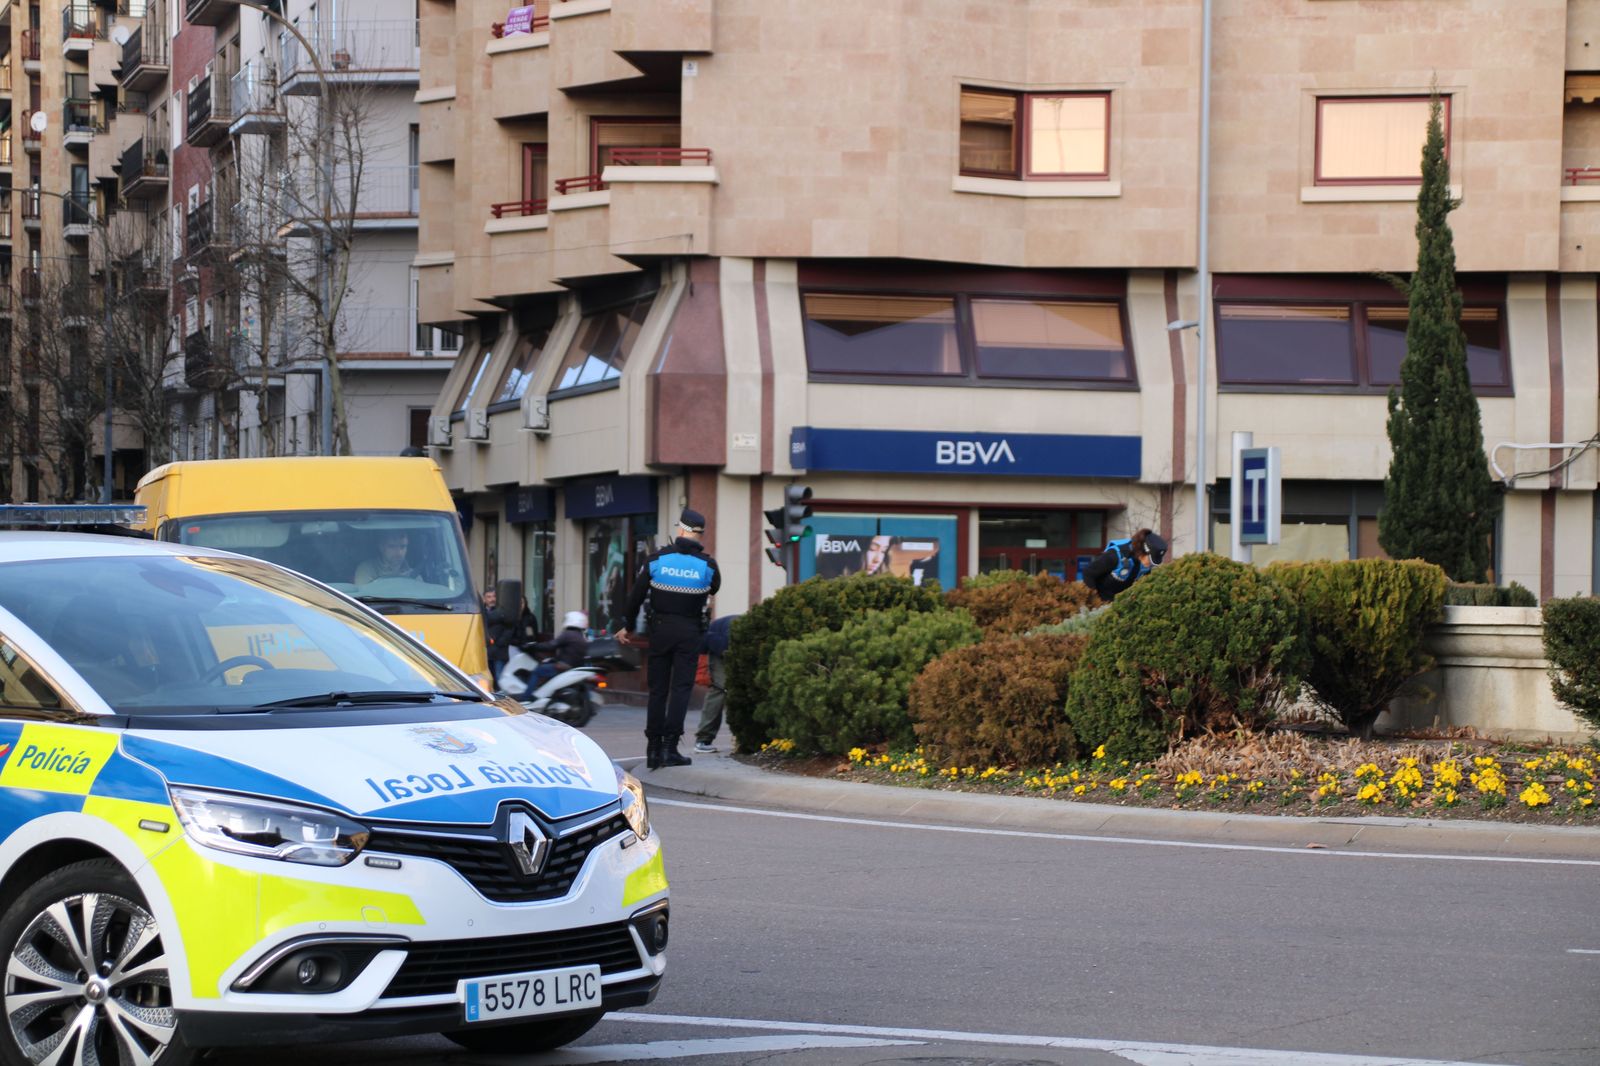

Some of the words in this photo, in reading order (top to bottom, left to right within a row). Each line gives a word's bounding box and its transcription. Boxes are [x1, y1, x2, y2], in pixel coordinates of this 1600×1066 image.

[936, 439, 1016, 466] BBVA
[821, 540, 861, 553] BBVA
[17, 745, 91, 774] Policía
[485, 978, 546, 1012] 5578
[555, 972, 596, 1005] LRC
[470, 1005, 476, 1014] E
